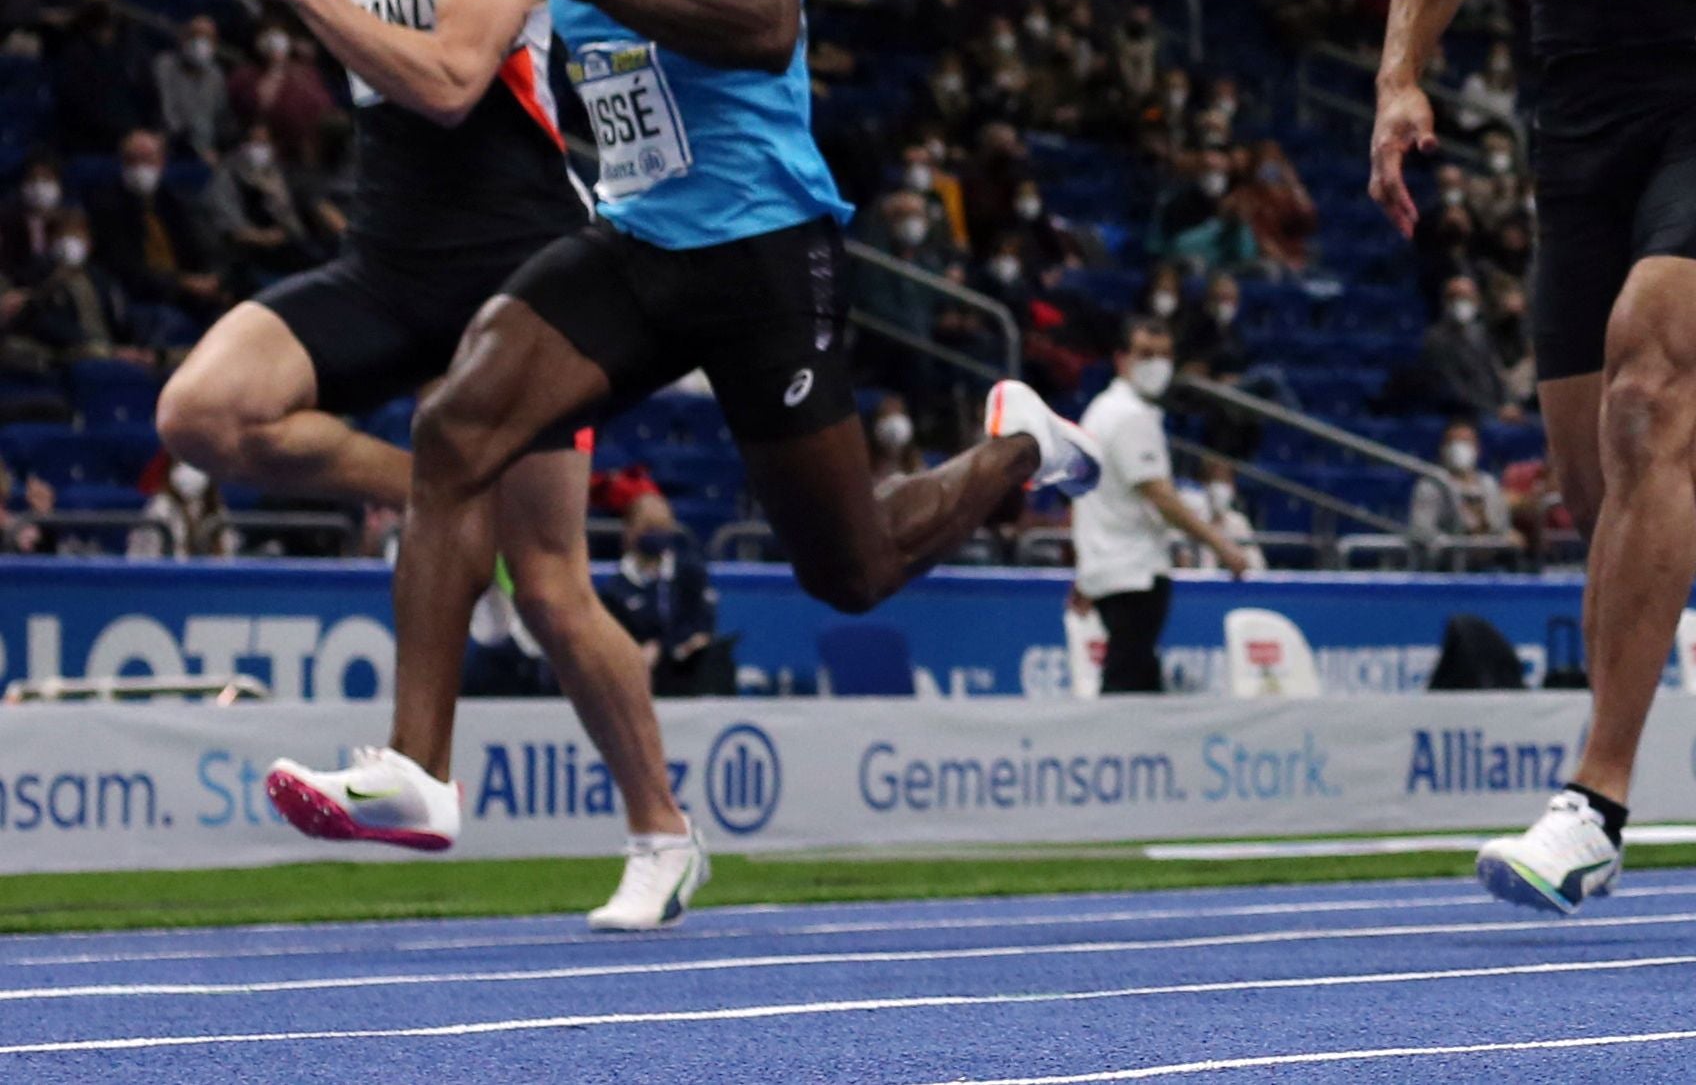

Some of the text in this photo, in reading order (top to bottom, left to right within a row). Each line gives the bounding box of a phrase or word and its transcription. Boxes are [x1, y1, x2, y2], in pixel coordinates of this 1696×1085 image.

[859, 733, 1342, 812] Gemeinsam. Stark.
[1403, 731, 1565, 794] Allianz
